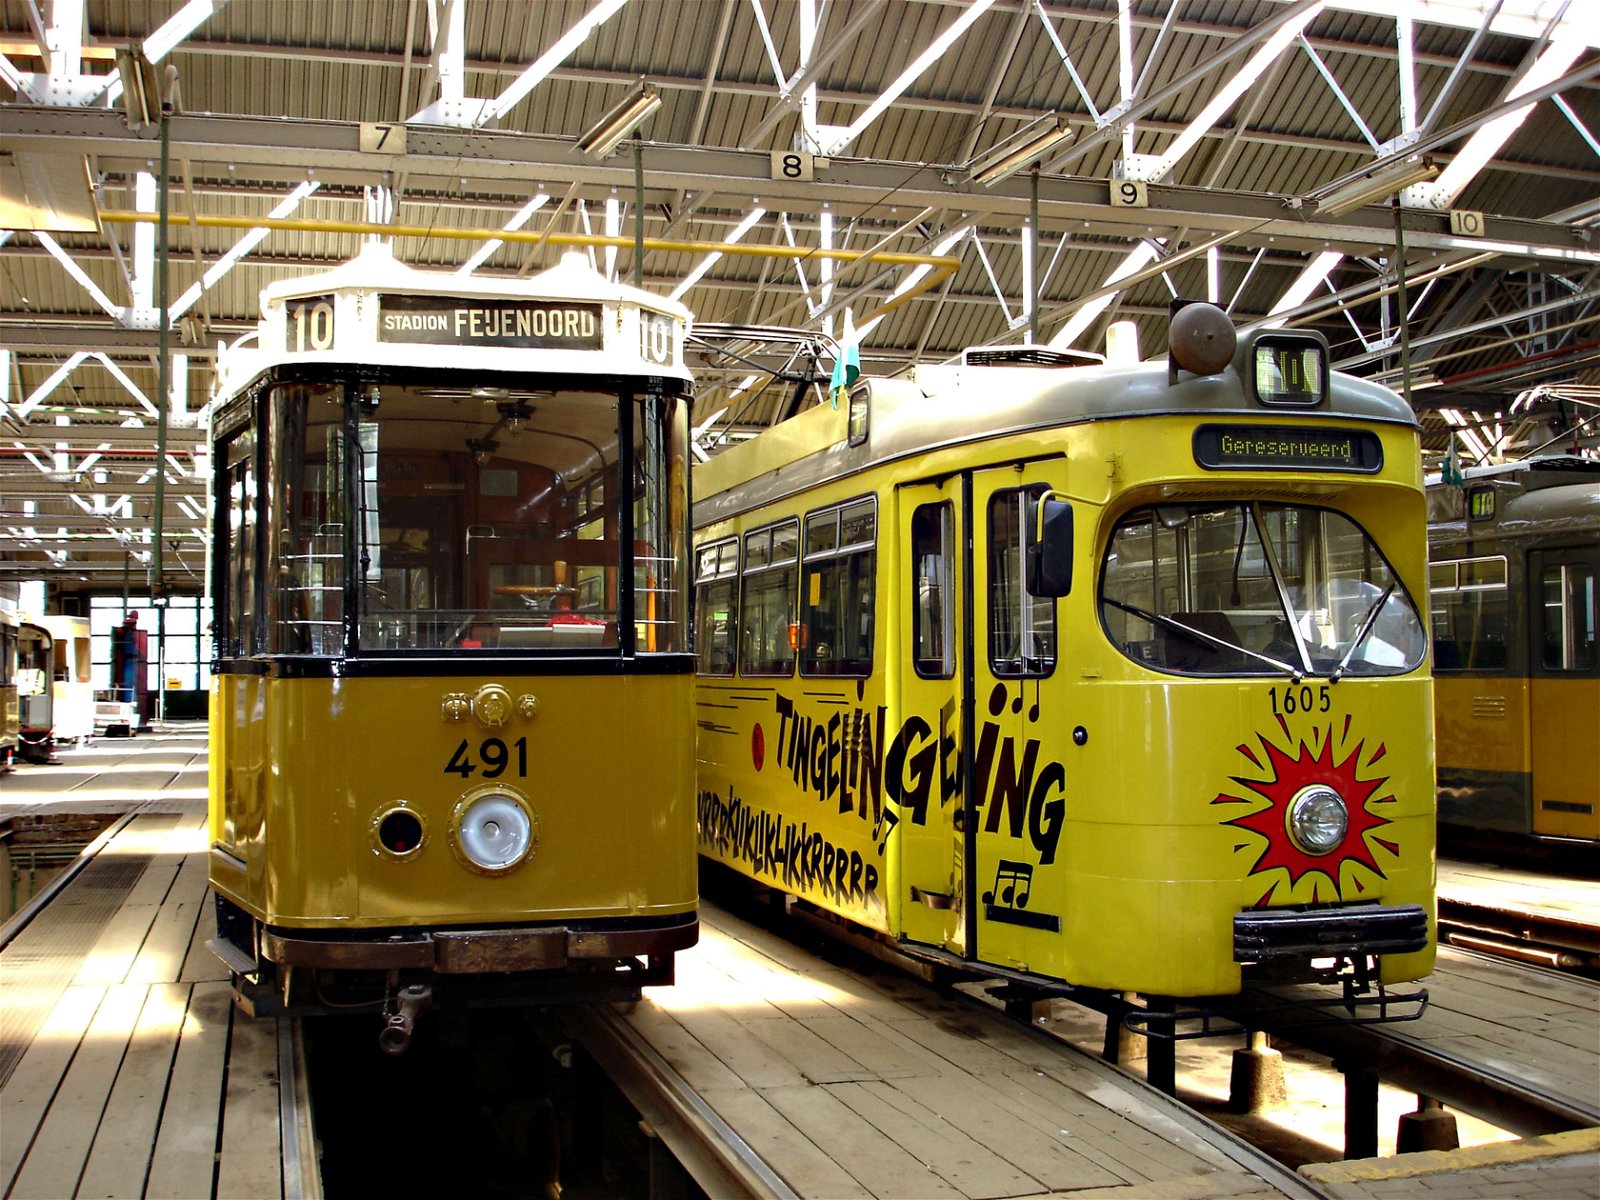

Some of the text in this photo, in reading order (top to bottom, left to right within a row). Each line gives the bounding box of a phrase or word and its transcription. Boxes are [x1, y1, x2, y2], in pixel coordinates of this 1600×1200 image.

[375, 126, 392, 150] 7
[783, 155, 802, 178] 8
[1121, 183, 1138, 204] 9
[1456, 213, 1478, 233] 10
[293, 303, 333, 352] 10
[385, 315, 447, 331] STADION
[1268, 686, 1331, 715] 1605
[444, 737, 528, 778] 491
